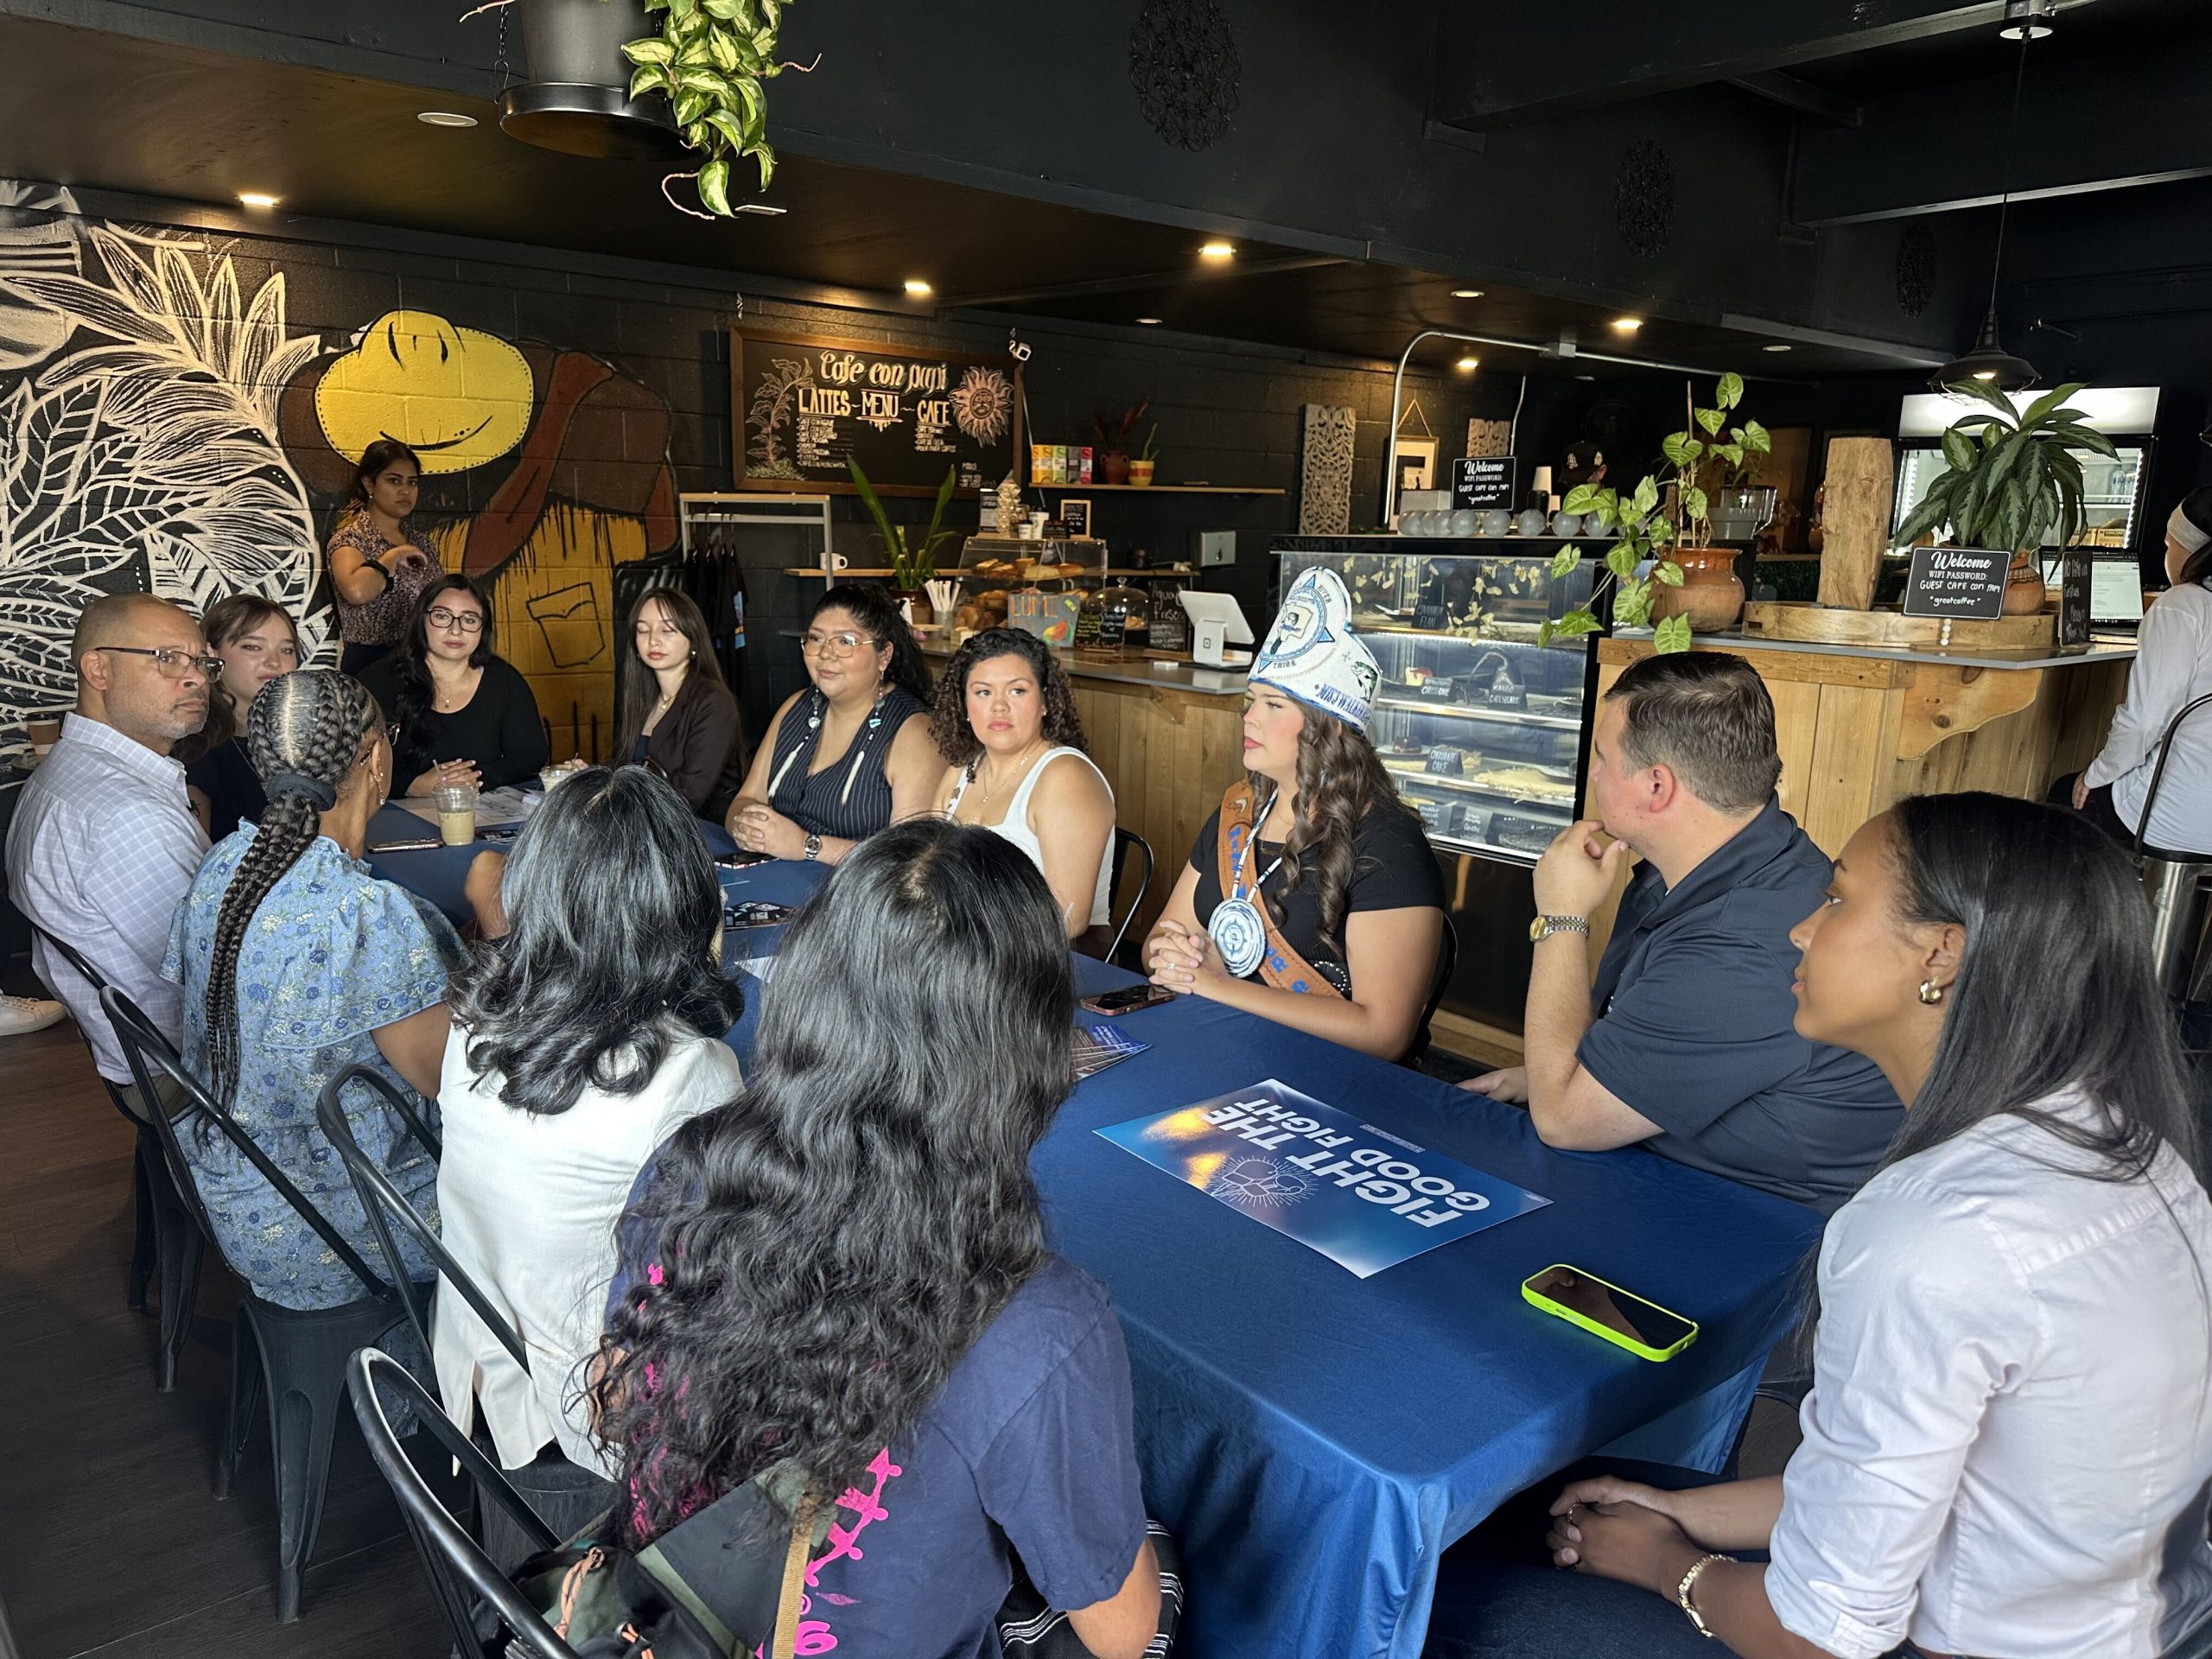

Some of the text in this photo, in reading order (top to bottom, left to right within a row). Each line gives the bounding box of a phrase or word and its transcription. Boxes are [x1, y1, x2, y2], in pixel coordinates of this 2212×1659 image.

[798, 388, 950, 424] LATTES MENU CAFE
[1465, 461, 1504, 474] Welcome
[1930, 551, 1993, 569] Welcome
[1919, 580, 1943, 590] GUEST
[1946, 571, 1988, 581] PASSWORD:
[1273, 660, 1297, 669] TRIBE
[1202, 1106, 1296, 1151] THE
[1233, 1098, 1354, 1148] FIGHT
[1285, 1154, 1464, 1228] FIGHT
[1351, 1148, 1491, 1211] GOOD
